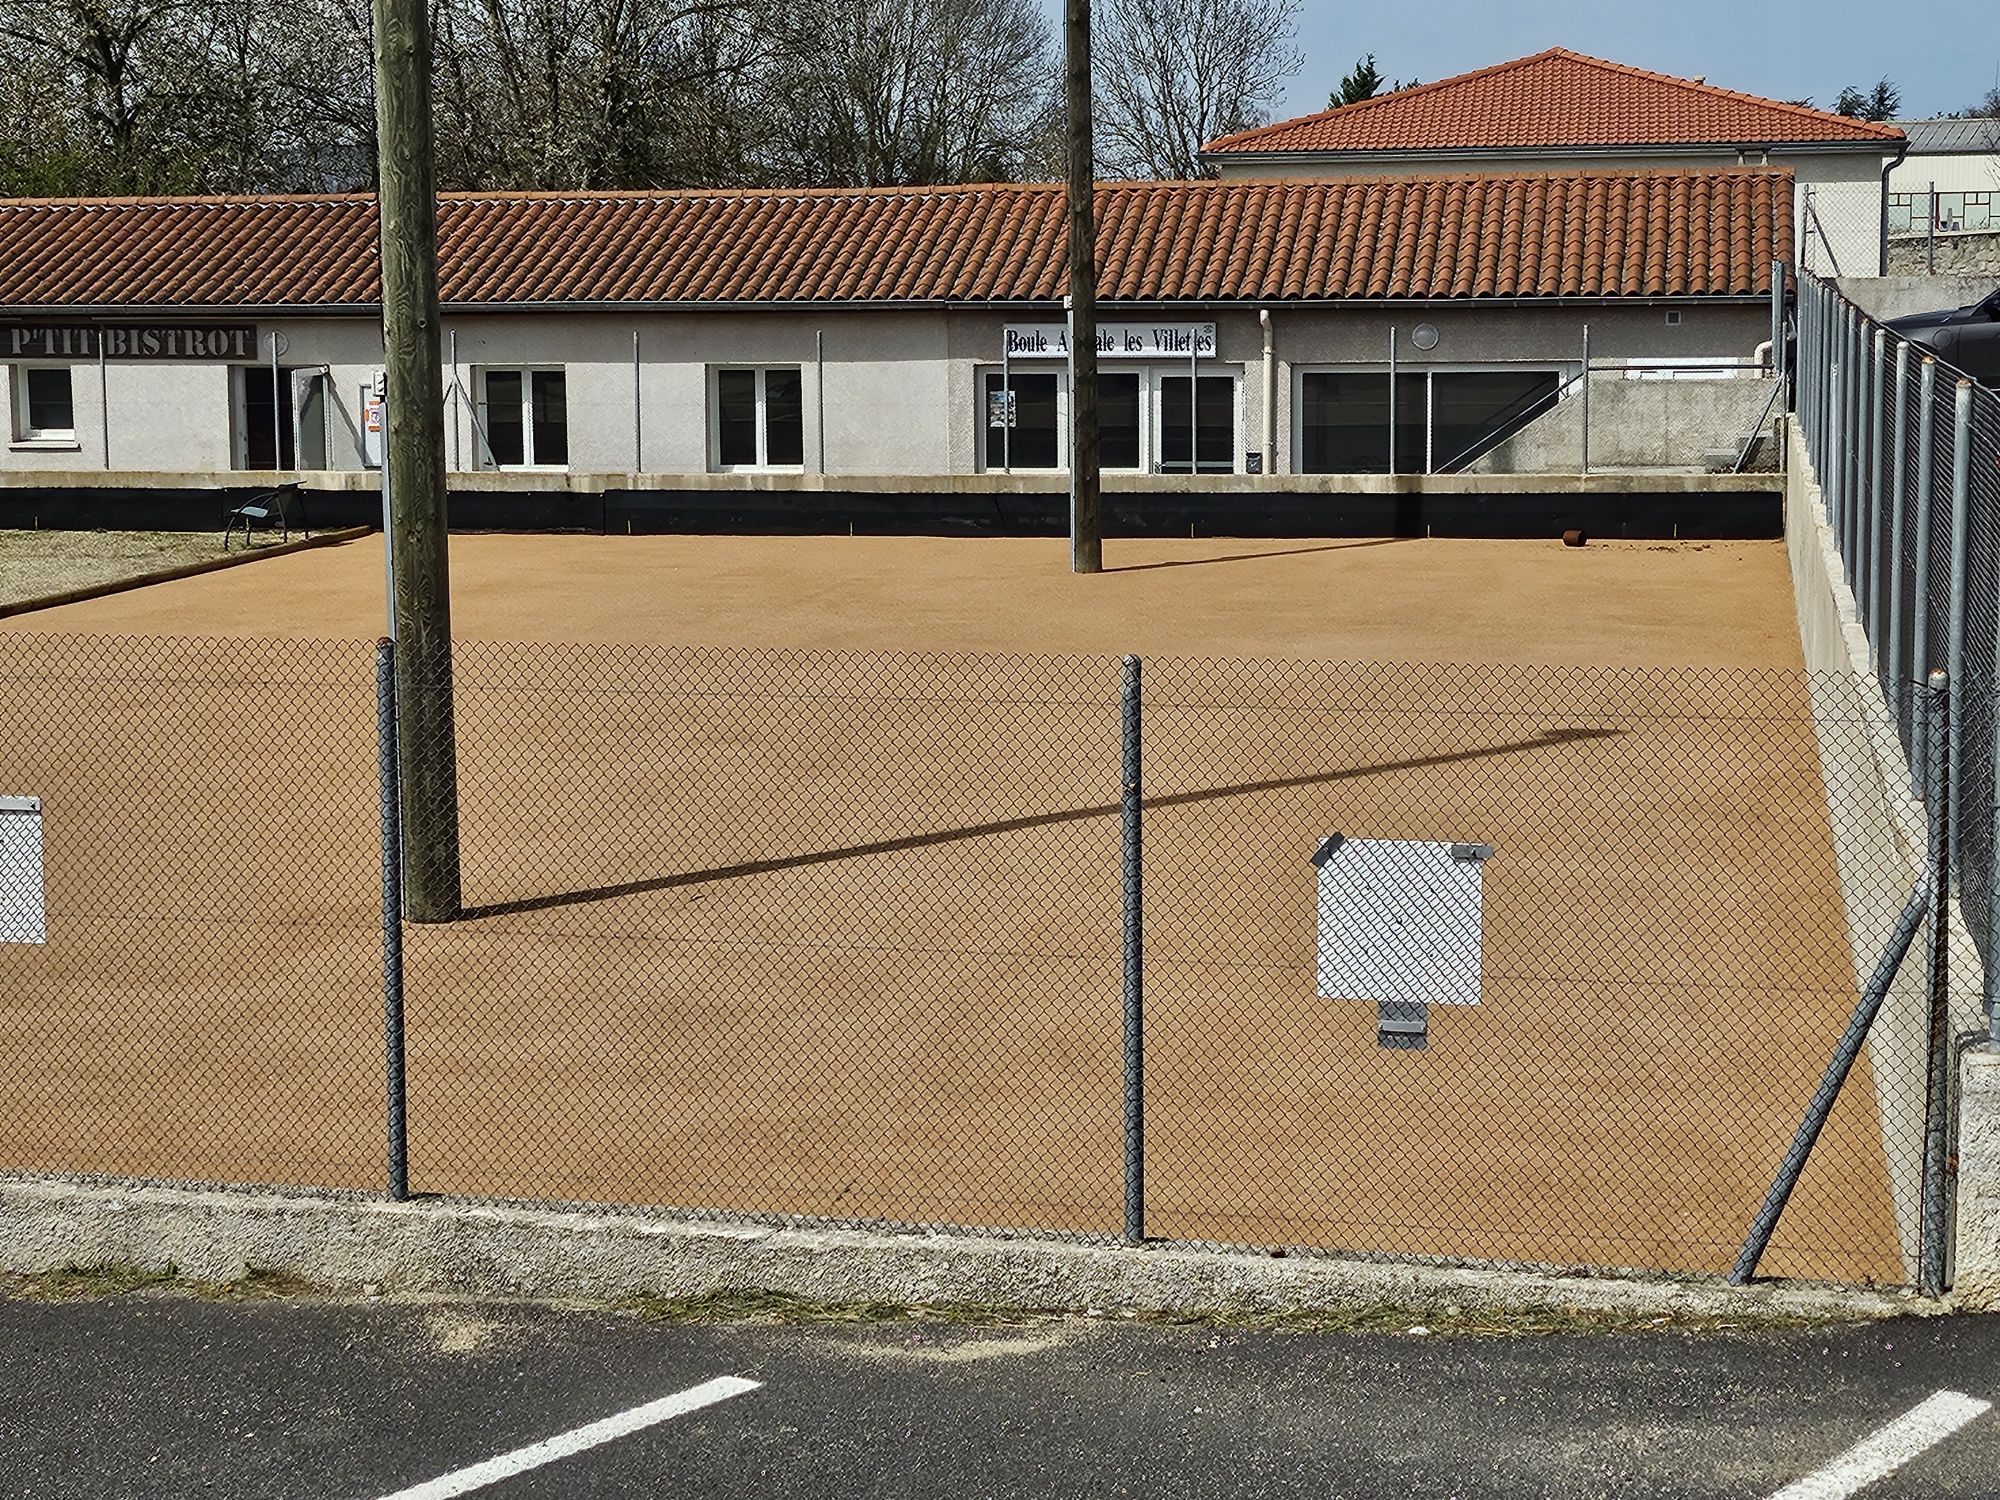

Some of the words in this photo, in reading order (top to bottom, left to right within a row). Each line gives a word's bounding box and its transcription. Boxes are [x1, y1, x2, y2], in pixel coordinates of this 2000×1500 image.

[11, 328, 96, 354] P'TIT
[107, 328, 249, 356] BISTROT
[1007, 330, 1047, 352] Boule
[1057, 330, 1115, 352] Aale
[1124, 329, 1143, 352] les
[1152, 329, 1212, 352] Villetes
